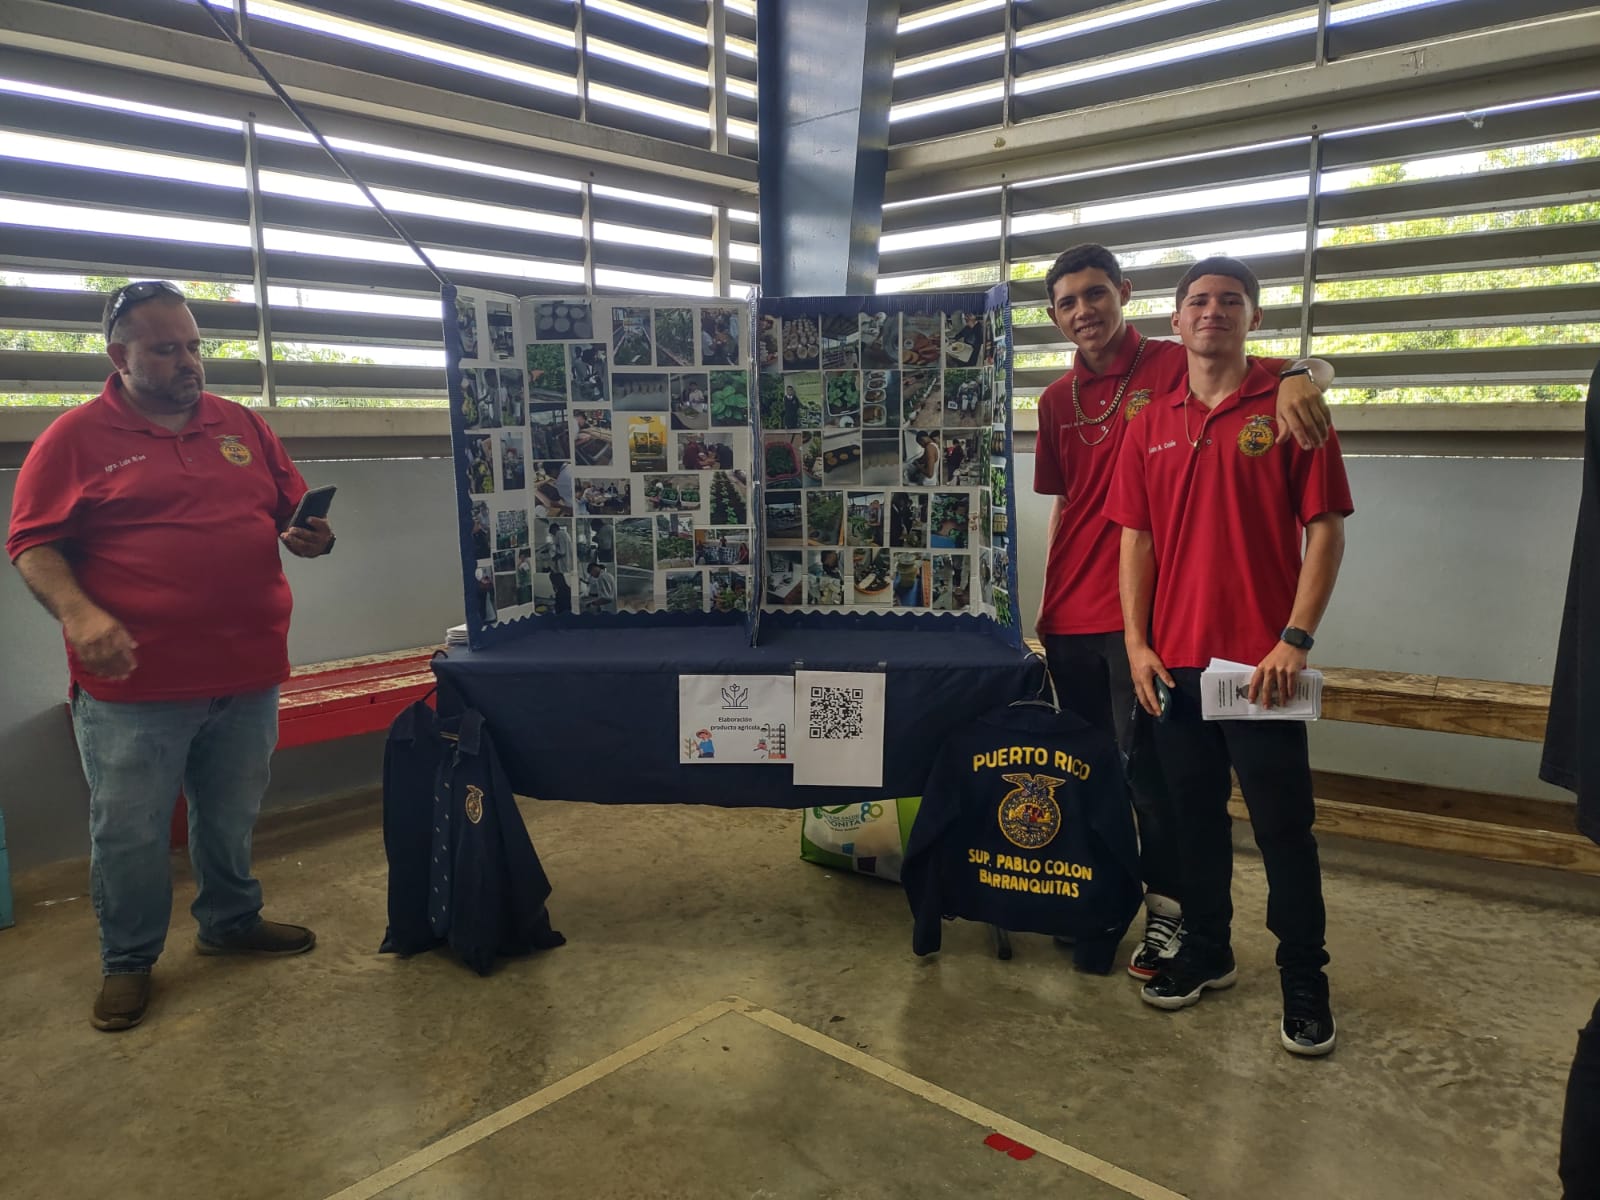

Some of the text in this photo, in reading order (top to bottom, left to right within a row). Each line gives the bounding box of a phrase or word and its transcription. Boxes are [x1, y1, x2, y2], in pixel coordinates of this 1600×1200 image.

[710, 724, 736, 732] producto
[973, 746, 1091, 780] PUERTO RICO
[968, 849, 1093, 881] SUP. PABLO COLON
[979, 869, 1080, 898] BARRANQUITAS
